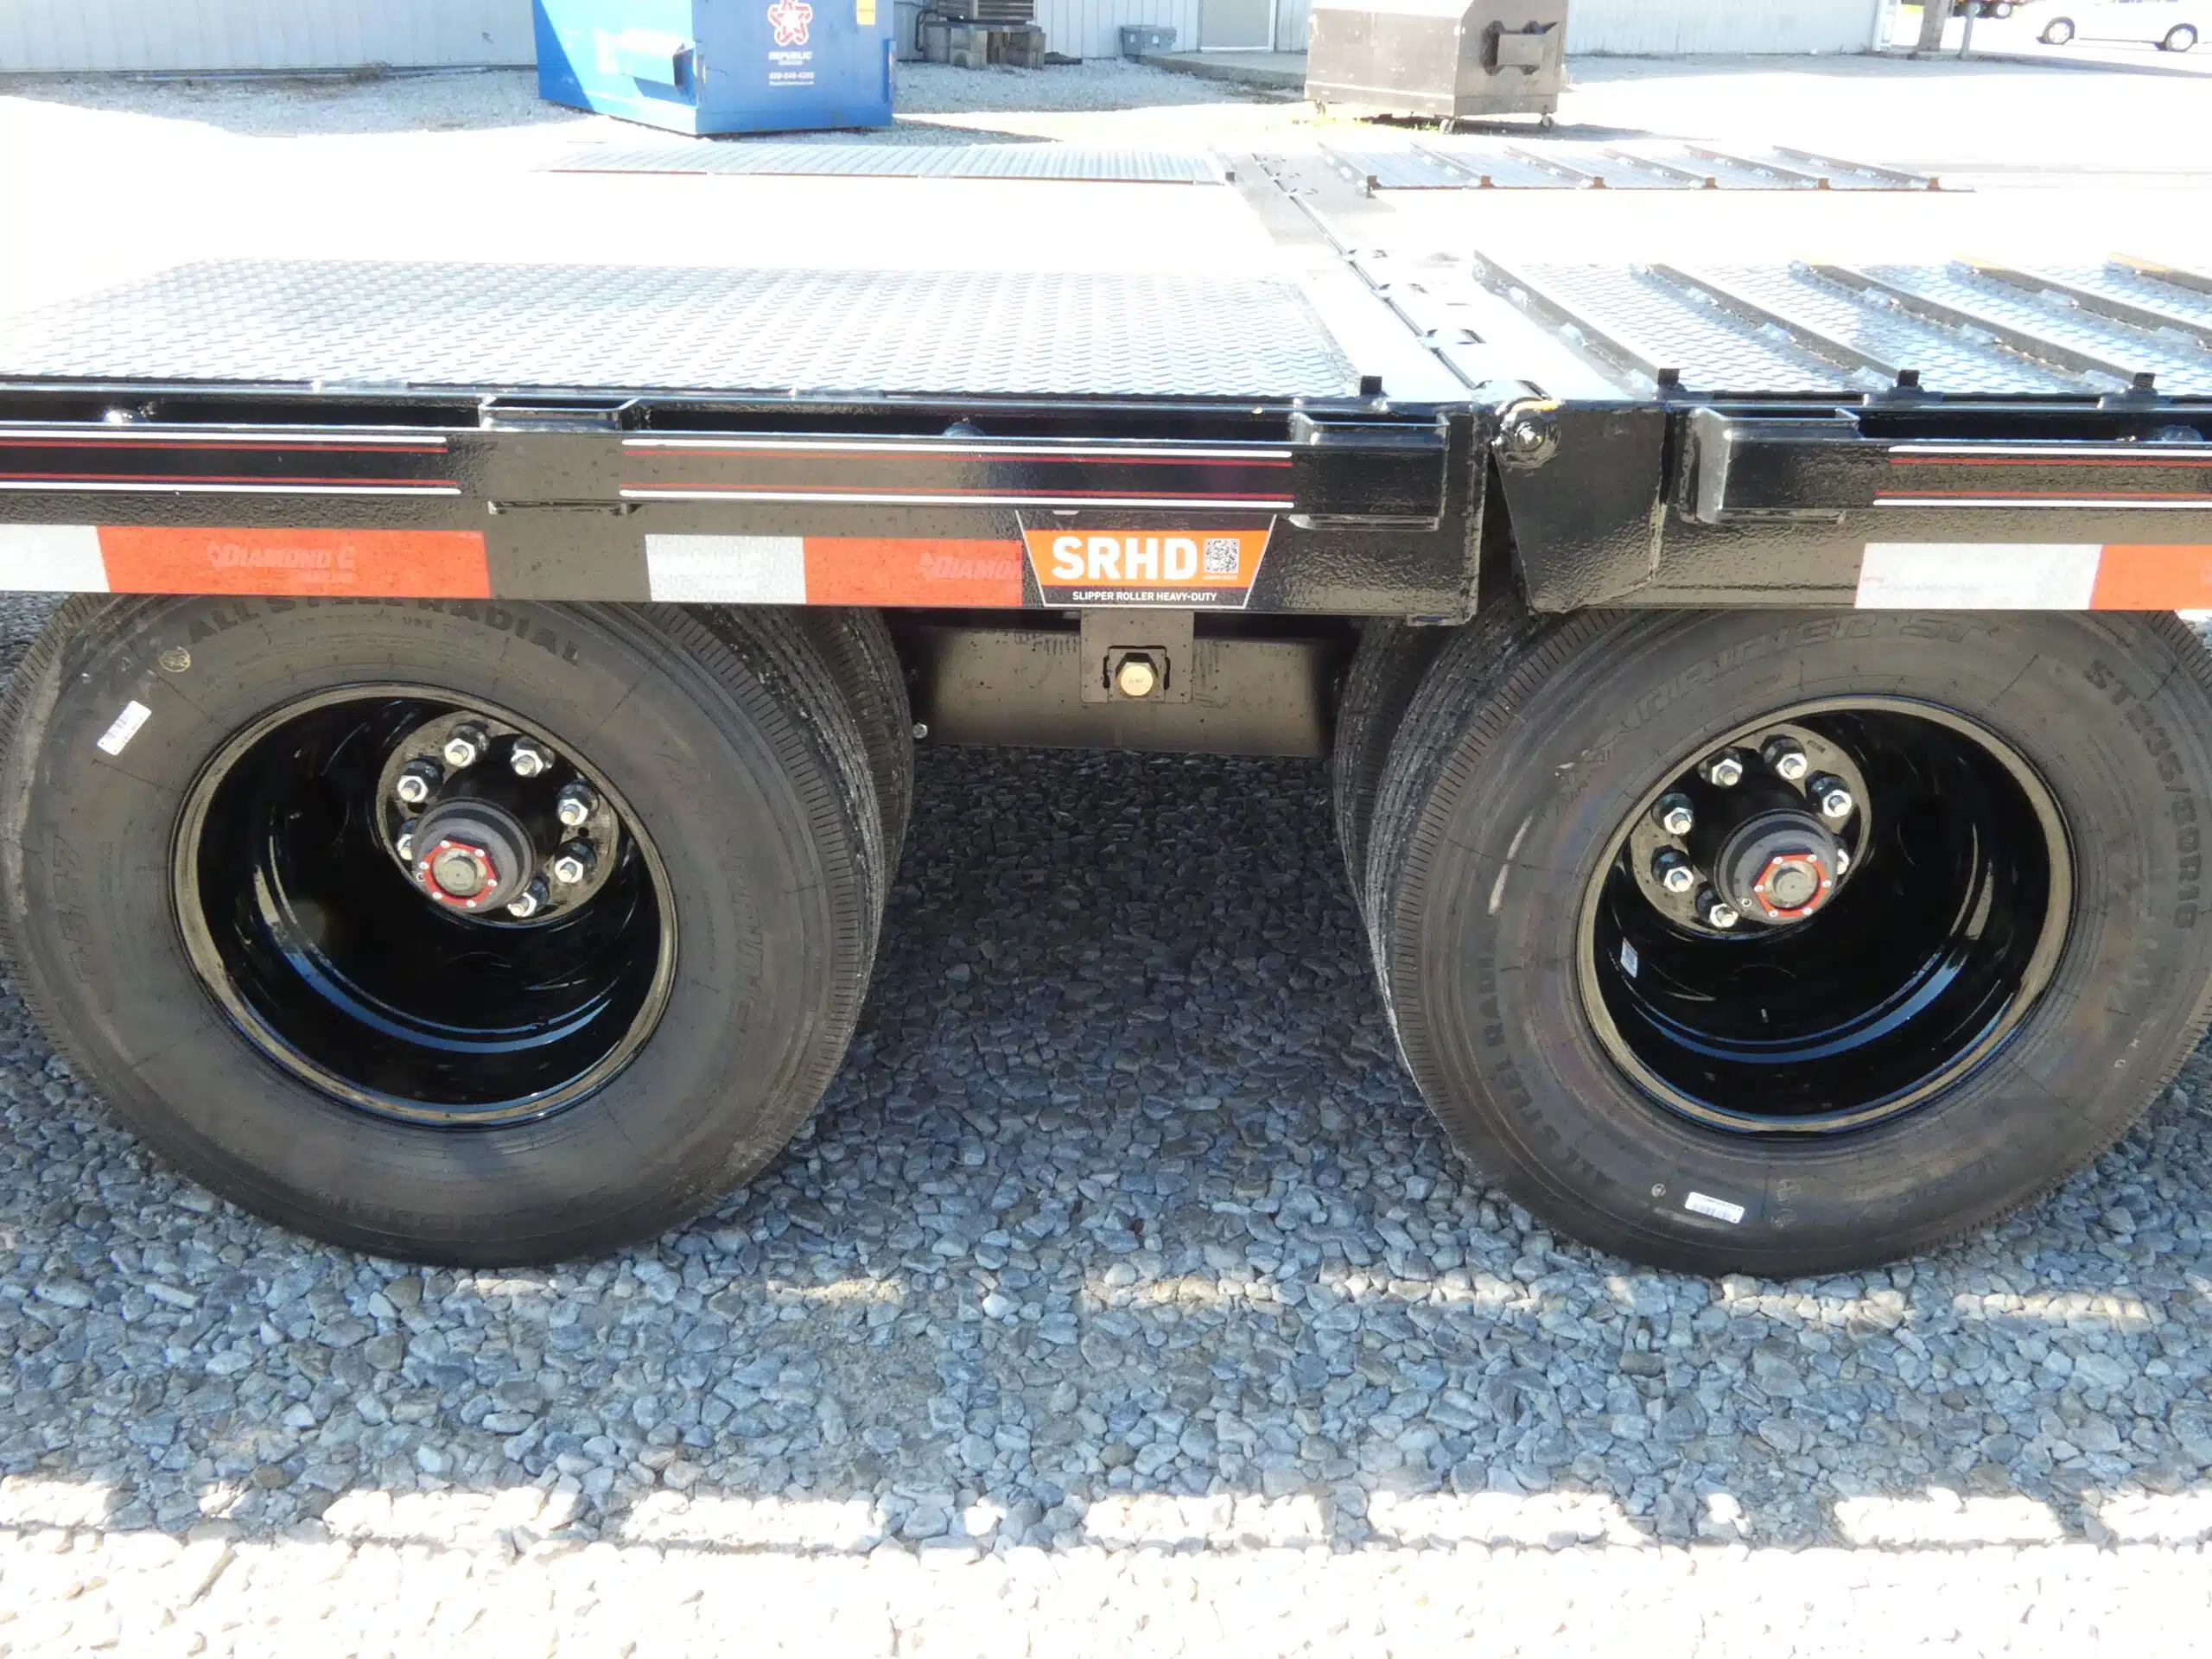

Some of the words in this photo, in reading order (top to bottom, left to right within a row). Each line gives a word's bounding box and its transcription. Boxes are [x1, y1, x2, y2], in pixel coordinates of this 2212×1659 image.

[1052, 536, 1198, 581] SRHD
[1072, 590, 1115, 601] SLIPPER
[1116, 591, 1154, 601] ROLLER
[1156, 591, 1217, 602] HEAVY-DUTY
